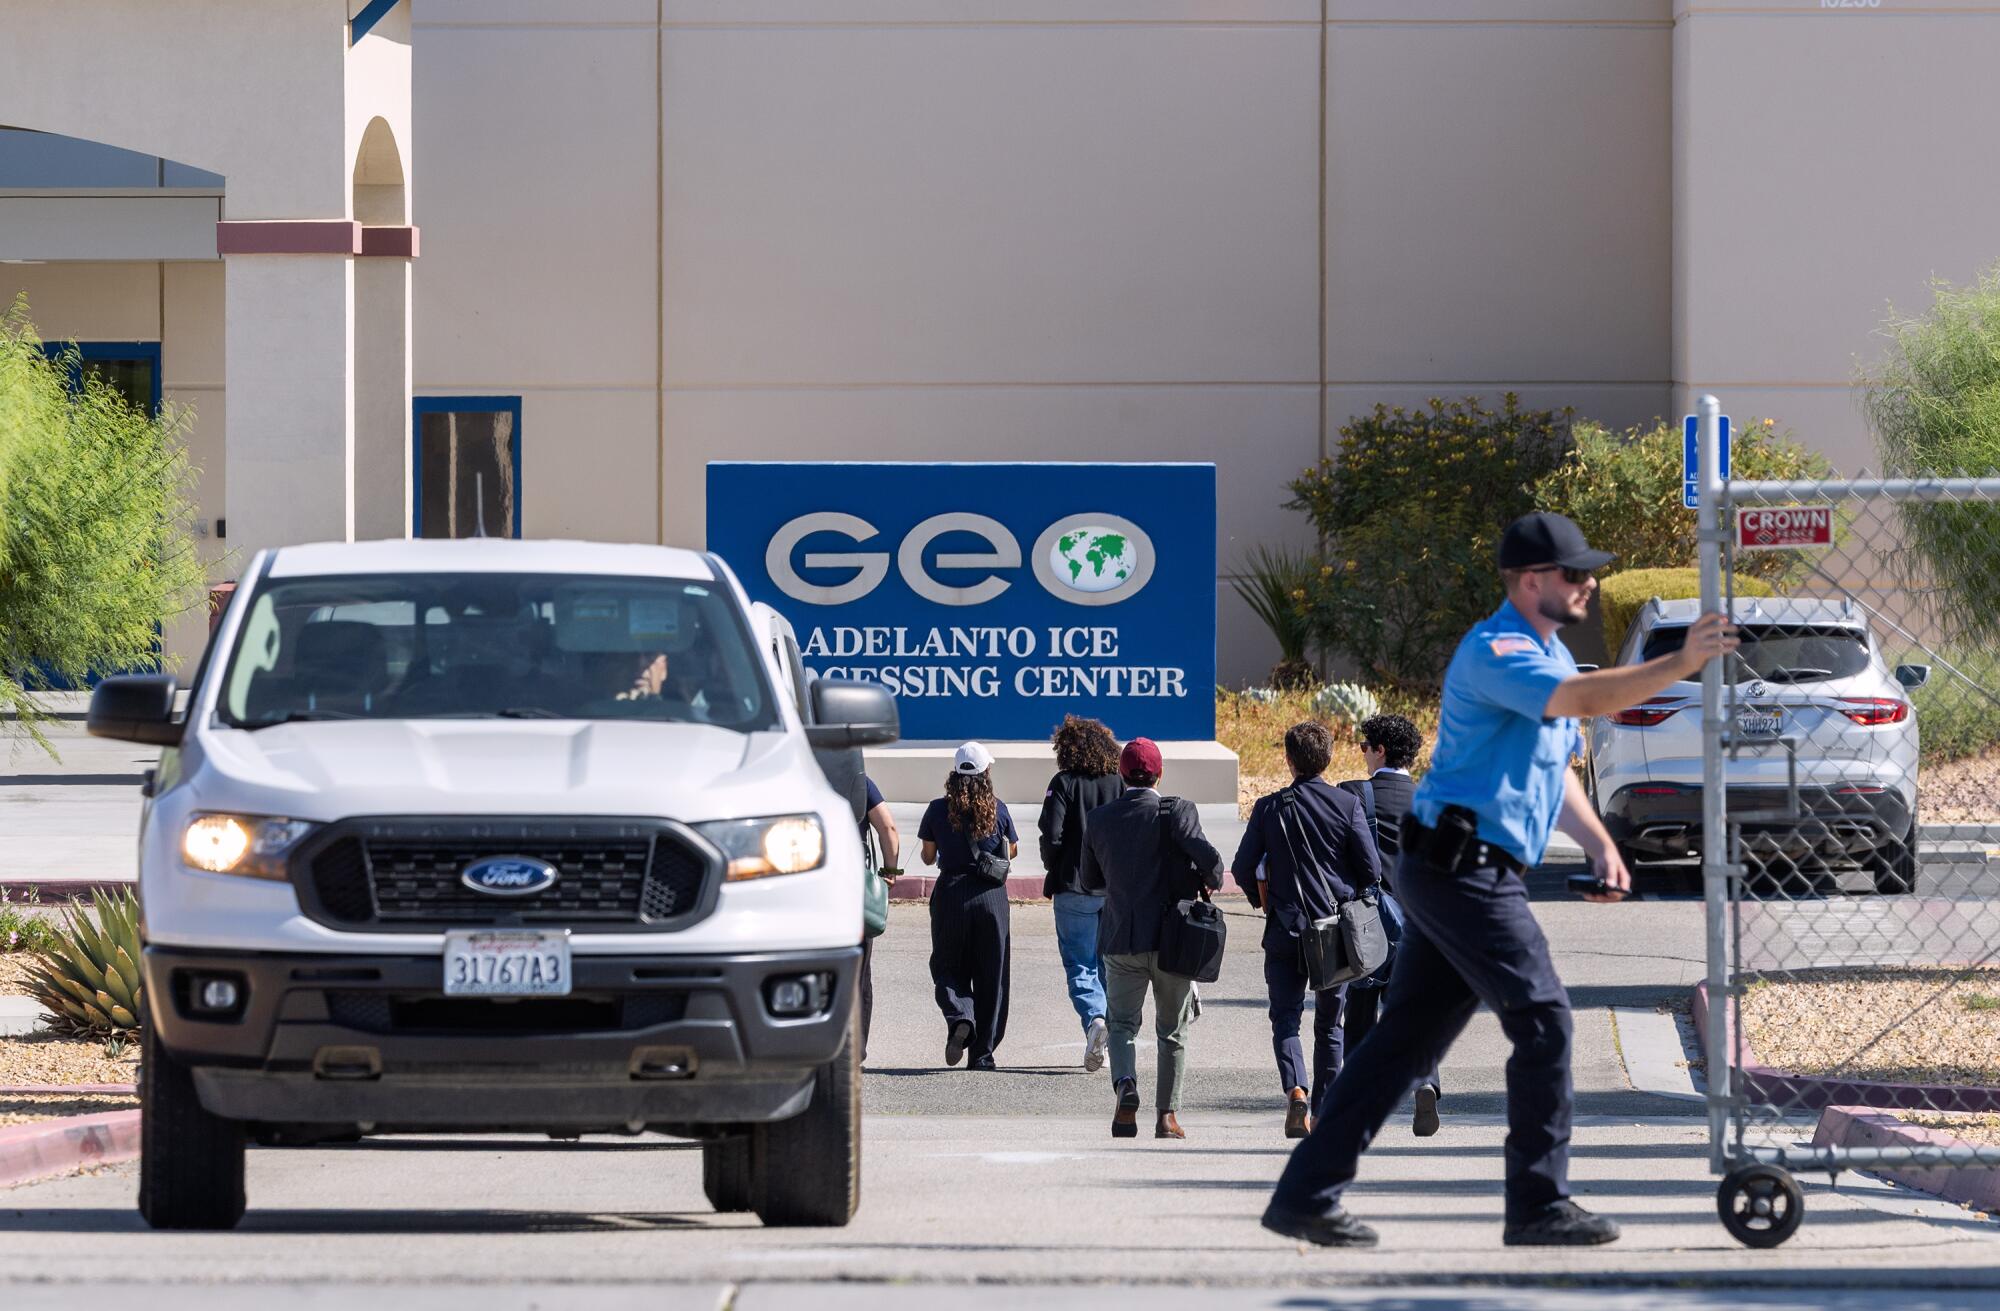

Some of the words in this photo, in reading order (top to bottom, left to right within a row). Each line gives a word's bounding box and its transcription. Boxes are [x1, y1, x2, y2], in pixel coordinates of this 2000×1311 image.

[1744, 510, 1827, 531] CROWN
[801, 627, 1036, 657] ADELANTO
[1048, 627, 1119, 657] ICE
[805, 666, 1001, 697] ESSING
[1014, 666, 1187, 697] CENTER
[482, 864, 534, 886] Ford
[454, 955, 560, 984] 31767A3
